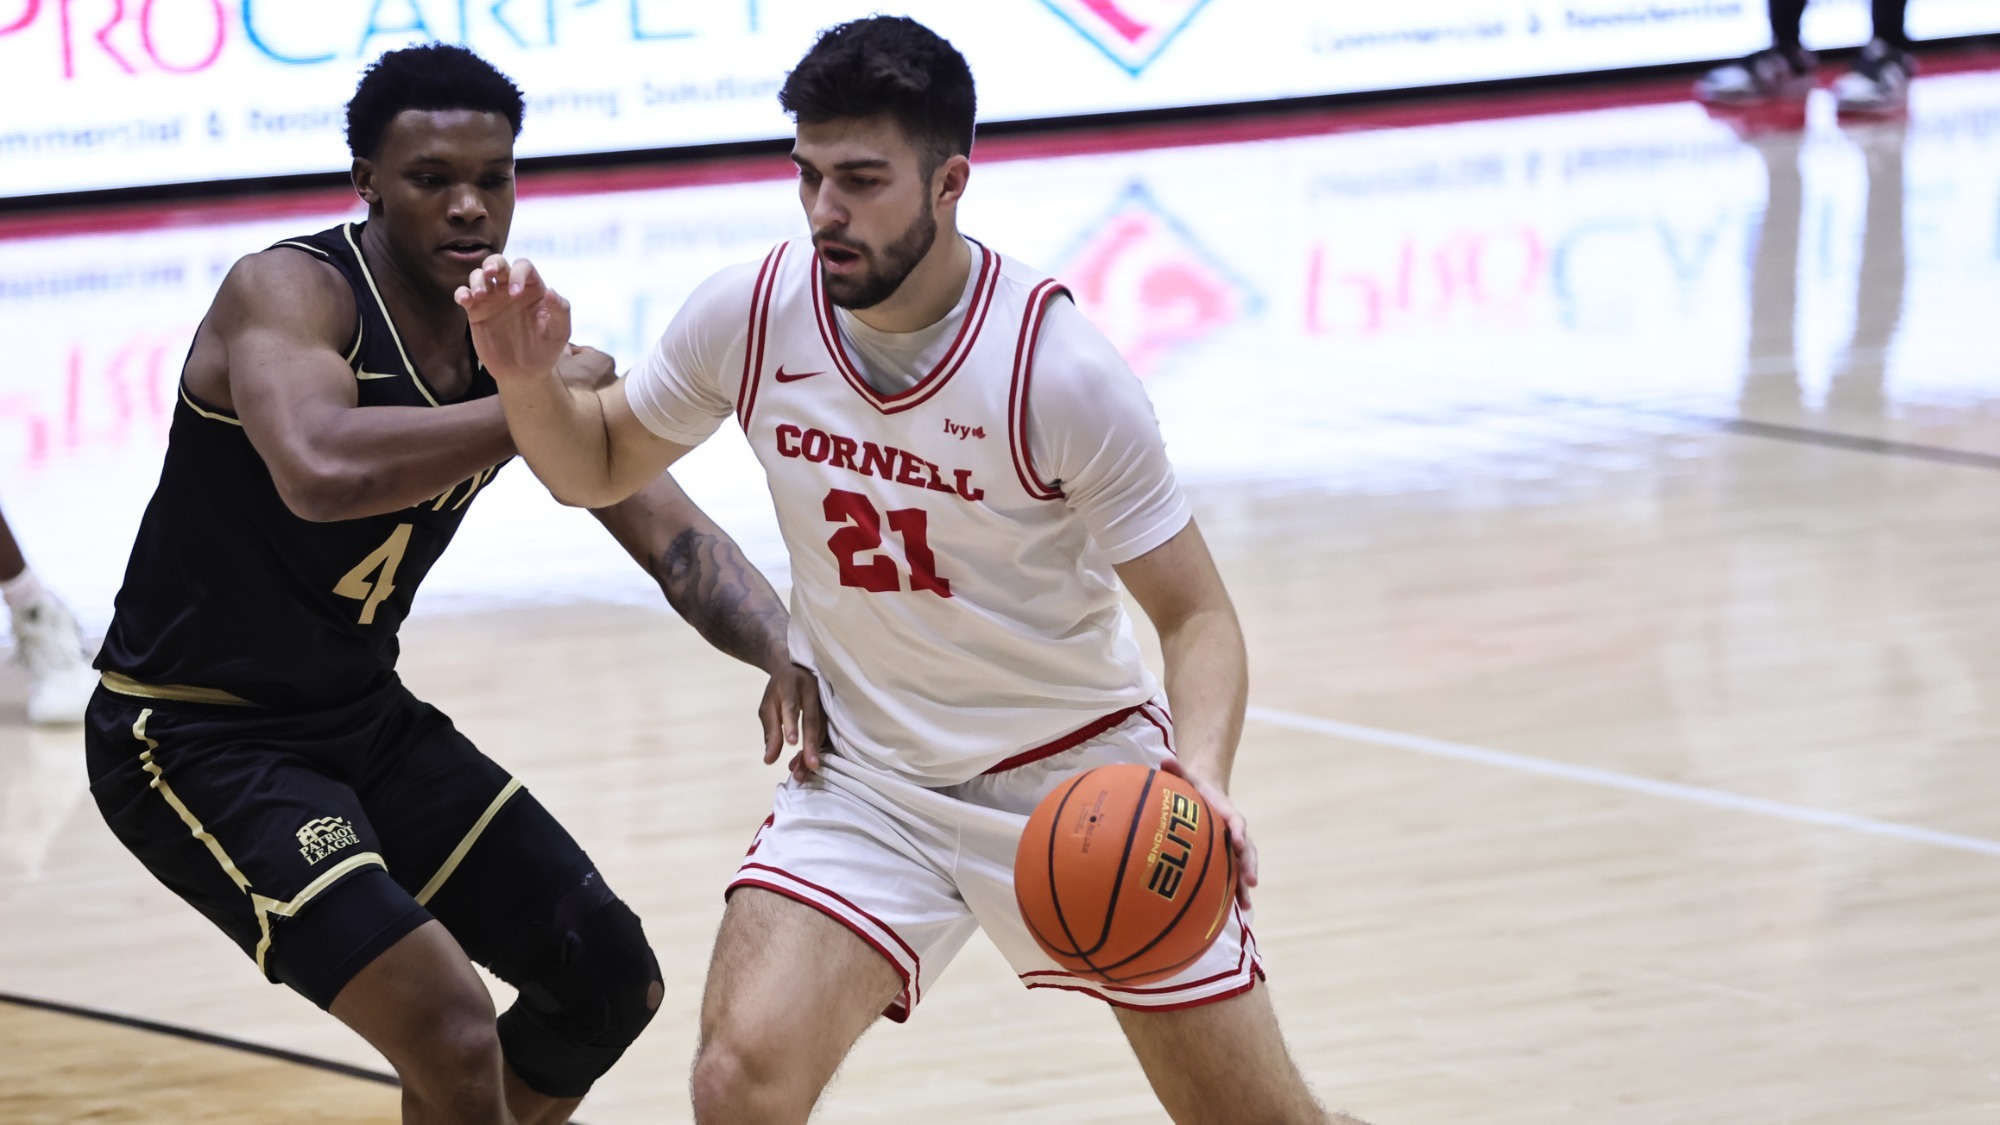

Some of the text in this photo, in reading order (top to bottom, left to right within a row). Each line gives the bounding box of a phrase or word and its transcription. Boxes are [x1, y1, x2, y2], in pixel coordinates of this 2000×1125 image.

[776, 424, 985, 501] CORNELL
[943, 418, 971, 440] Ivy
[332, 523, 413, 625] 4
[822, 488, 954, 598] 21
[299, 825, 354, 858] PATRIOT
[304, 834, 360, 866] LEAGUE
[1140, 787, 1172, 888] CHAMPIONS
[1147, 791, 1200, 902] ELITE
